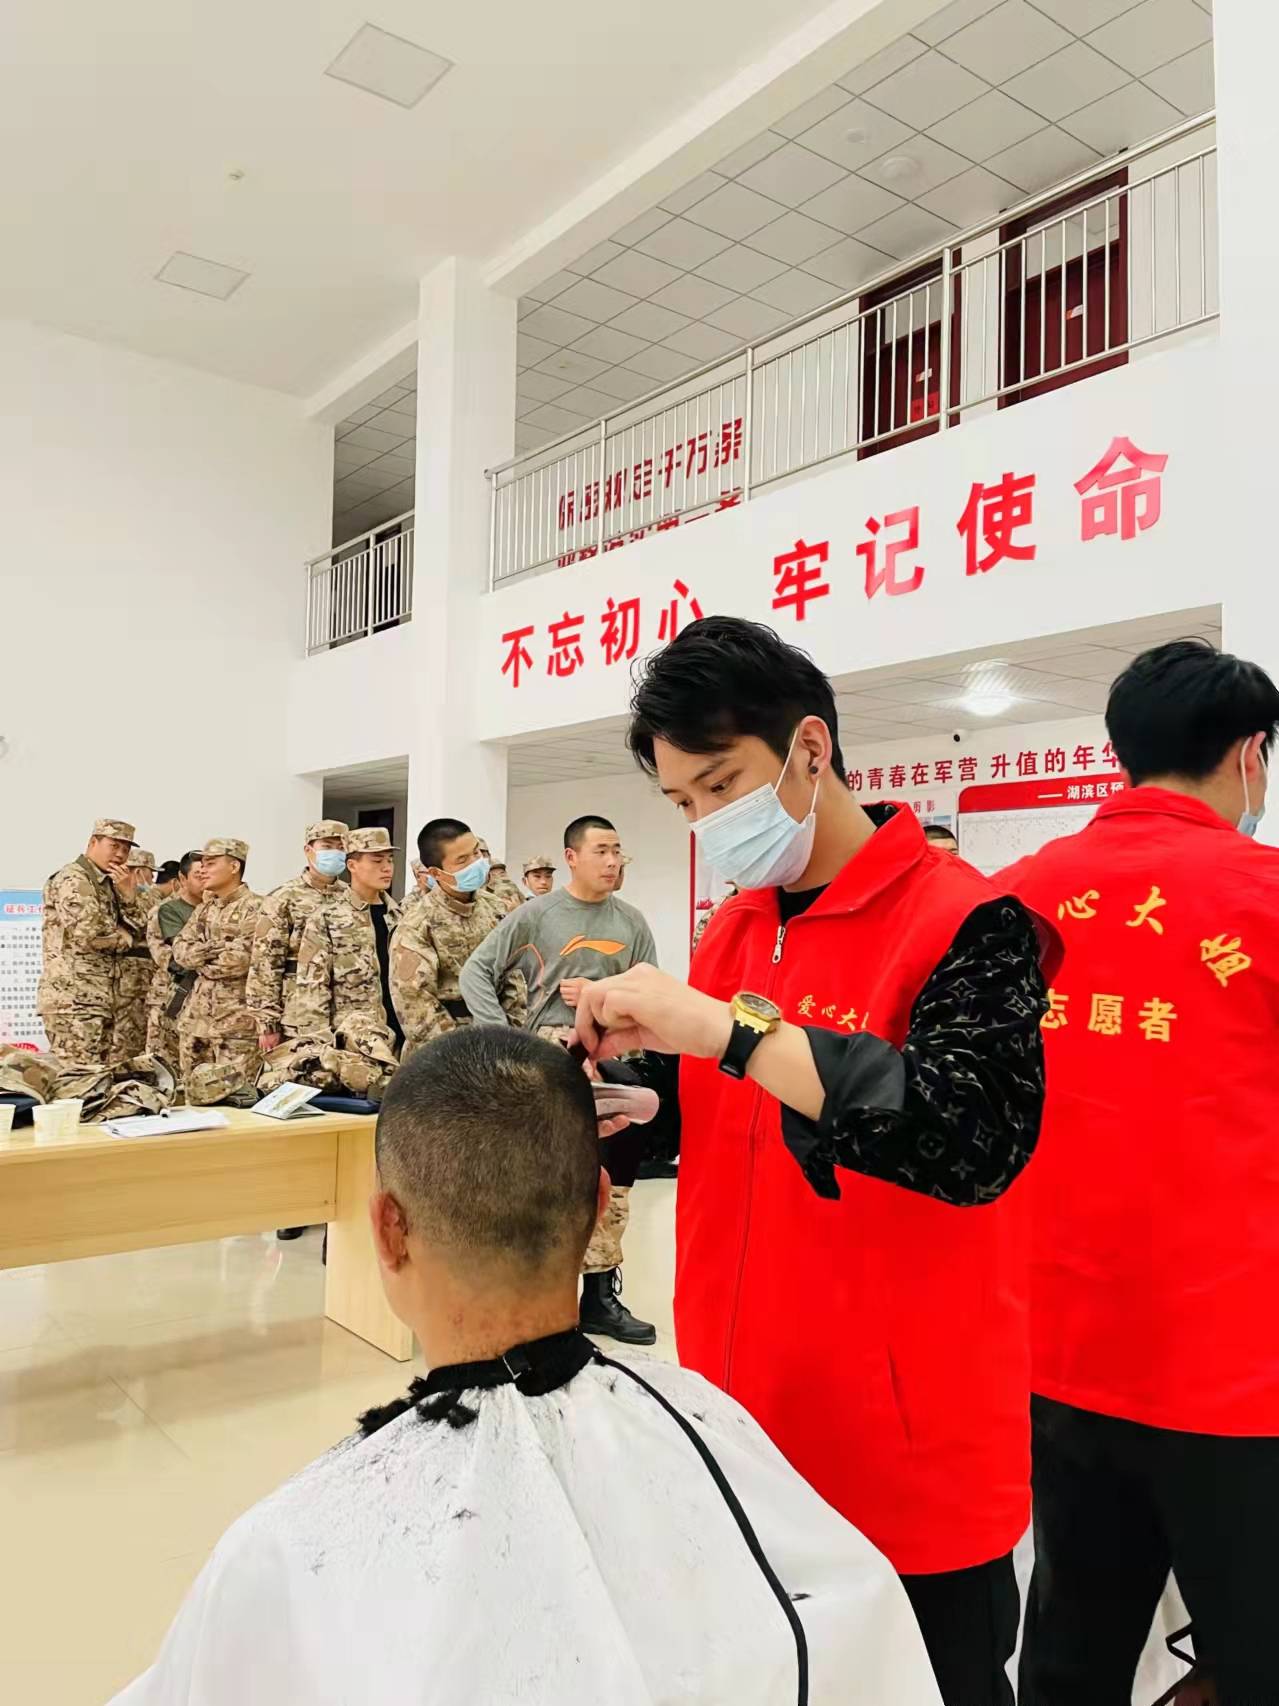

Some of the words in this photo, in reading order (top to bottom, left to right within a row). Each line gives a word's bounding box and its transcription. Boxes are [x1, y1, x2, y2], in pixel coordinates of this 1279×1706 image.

[501, 578, 705, 688] 不忘初心
[772, 436, 1169, 621] 牢记使命
[847, 756, 978, 791] 的青春在军营
[797, 994, 870, 1031] 爱心大
[1039, 987, 1178, 1042] 志愿者
